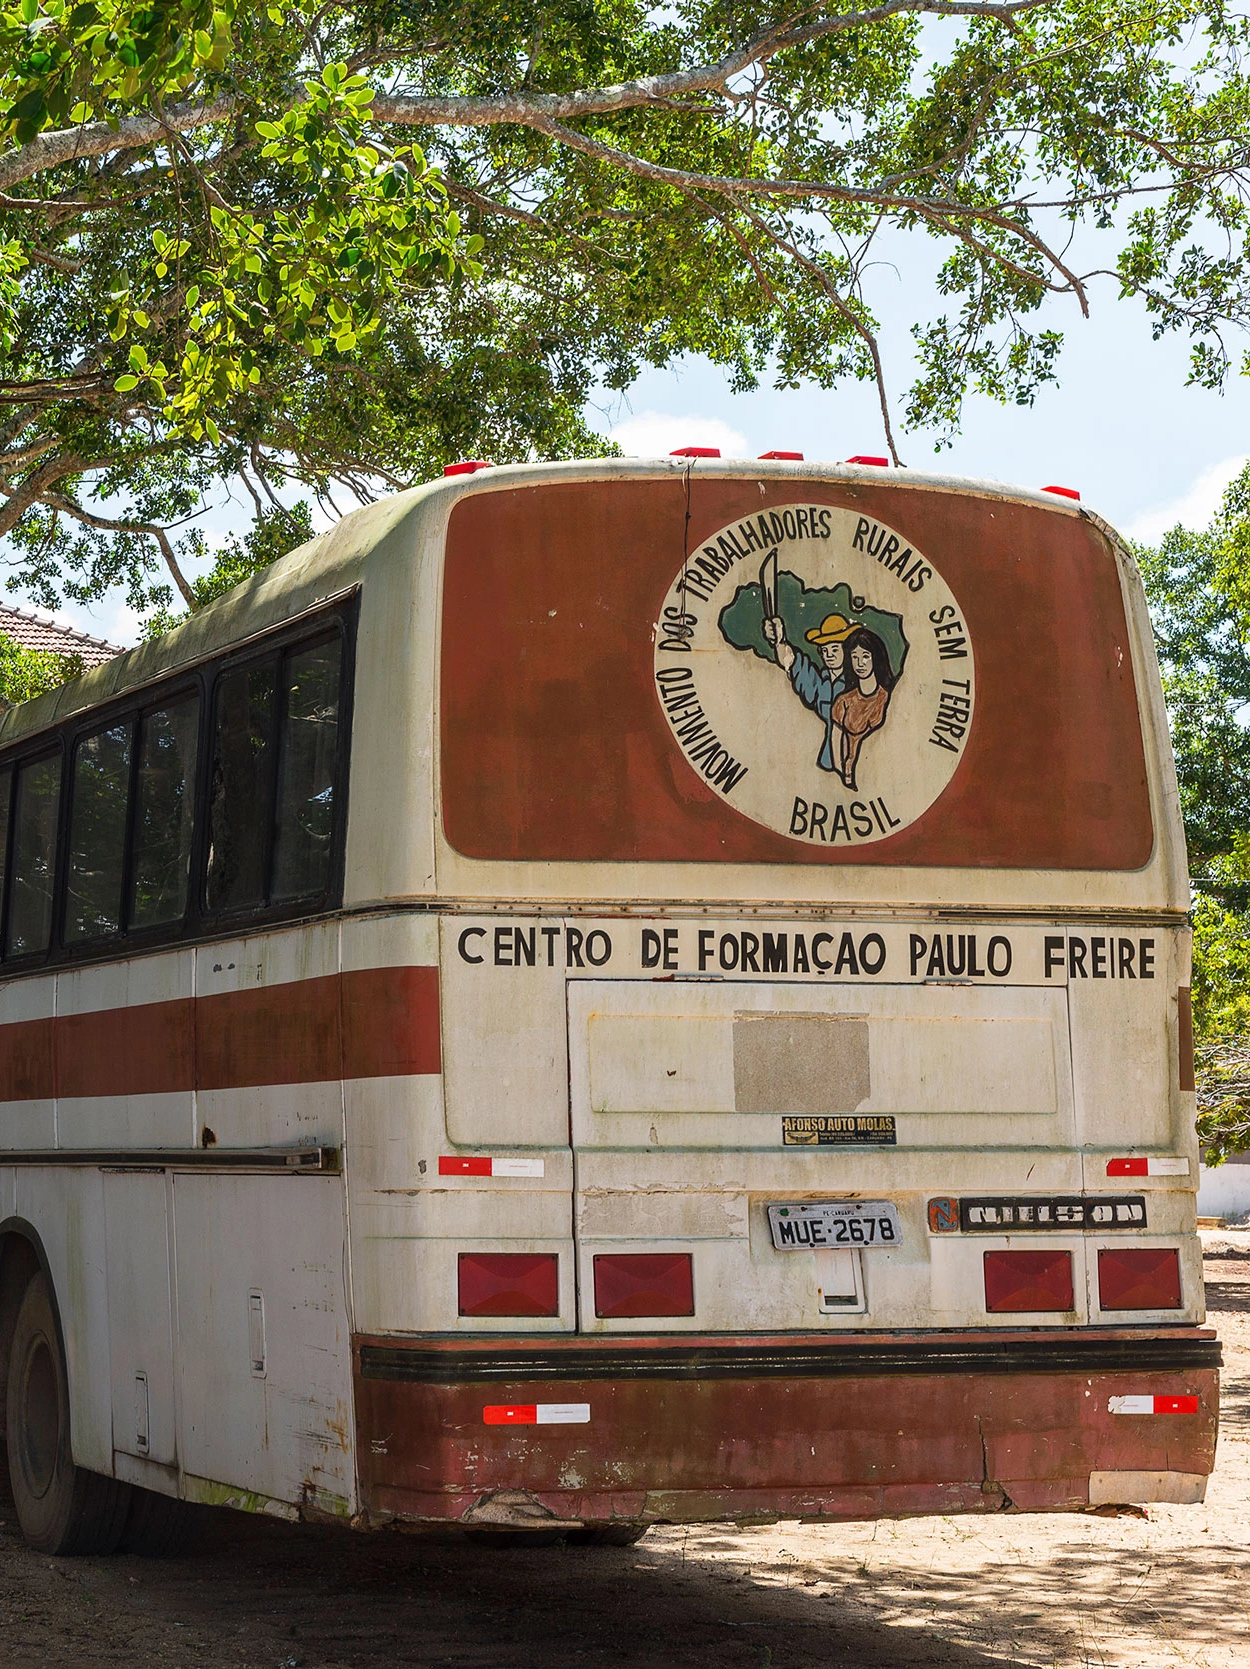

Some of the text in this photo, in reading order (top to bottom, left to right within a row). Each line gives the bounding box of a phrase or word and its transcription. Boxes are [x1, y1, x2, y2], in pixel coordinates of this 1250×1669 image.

[656, 508, 971, 794] MOVIMENTO DOS TRABALHADORES RURAIS SEM TERRA
[790, 796, 901, 842] BRASIL
[458, 927, 612, 967] CENTRO
[641, 928, 679, 970] DE
[909, 933, 1012, 977] PAULO
[1044, 936, 1155, 979] FREIRE
[784, 1117, 893, 1131] AFONSO AUTO MOLAS
